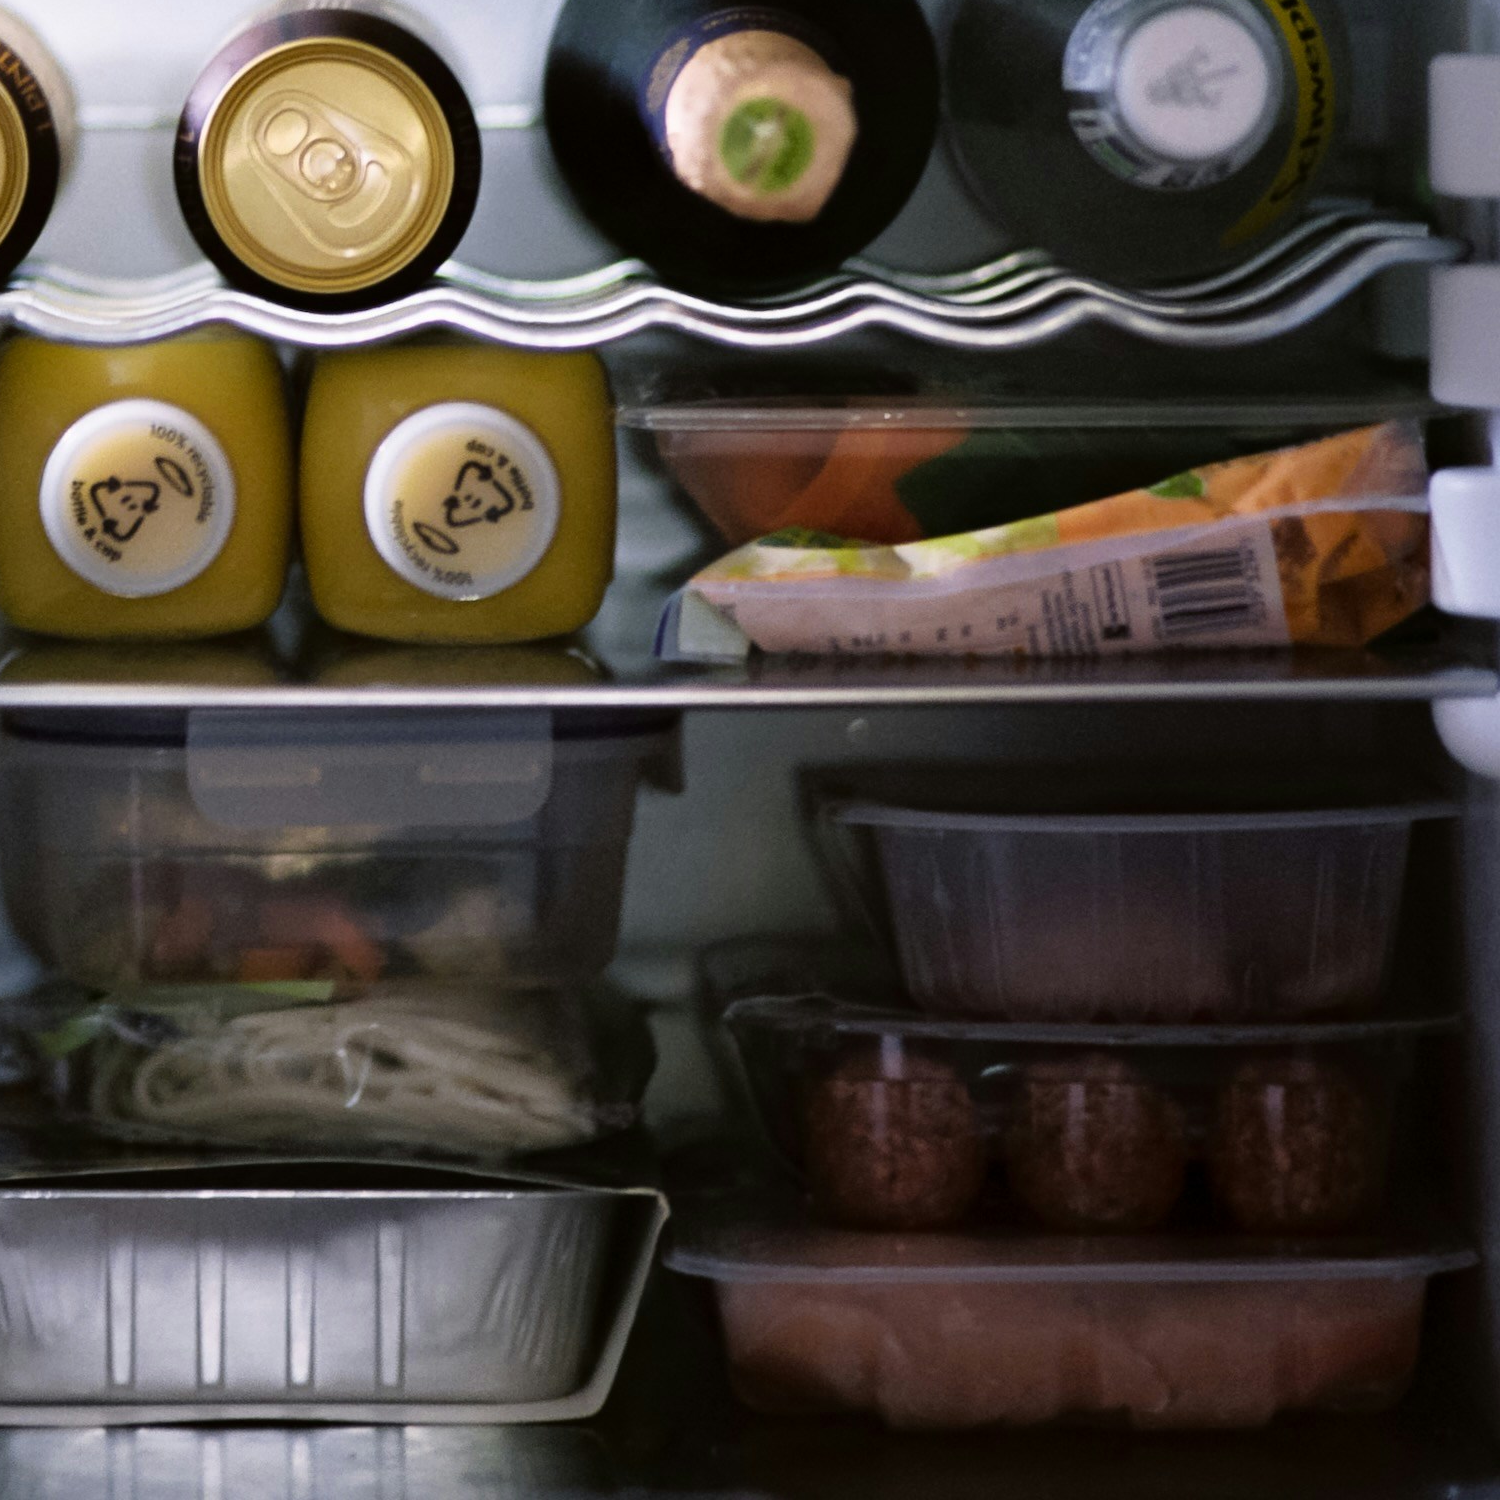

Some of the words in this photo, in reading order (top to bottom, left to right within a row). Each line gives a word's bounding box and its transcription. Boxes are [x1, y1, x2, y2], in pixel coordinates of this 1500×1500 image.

[151, 423, 187, 449] 100%
[187, 446, 216, 524] recyclable
[466, 439, 495, 458] cap
[510, 466, 534, 511] bottle
[70, 480, 88, 526] bottle
[84, 527, 97, 541] &
[93, 539, 123, 562] cap
[389, 498, 431, 573] recyclable
[432, 565, 475, 587] 100%
